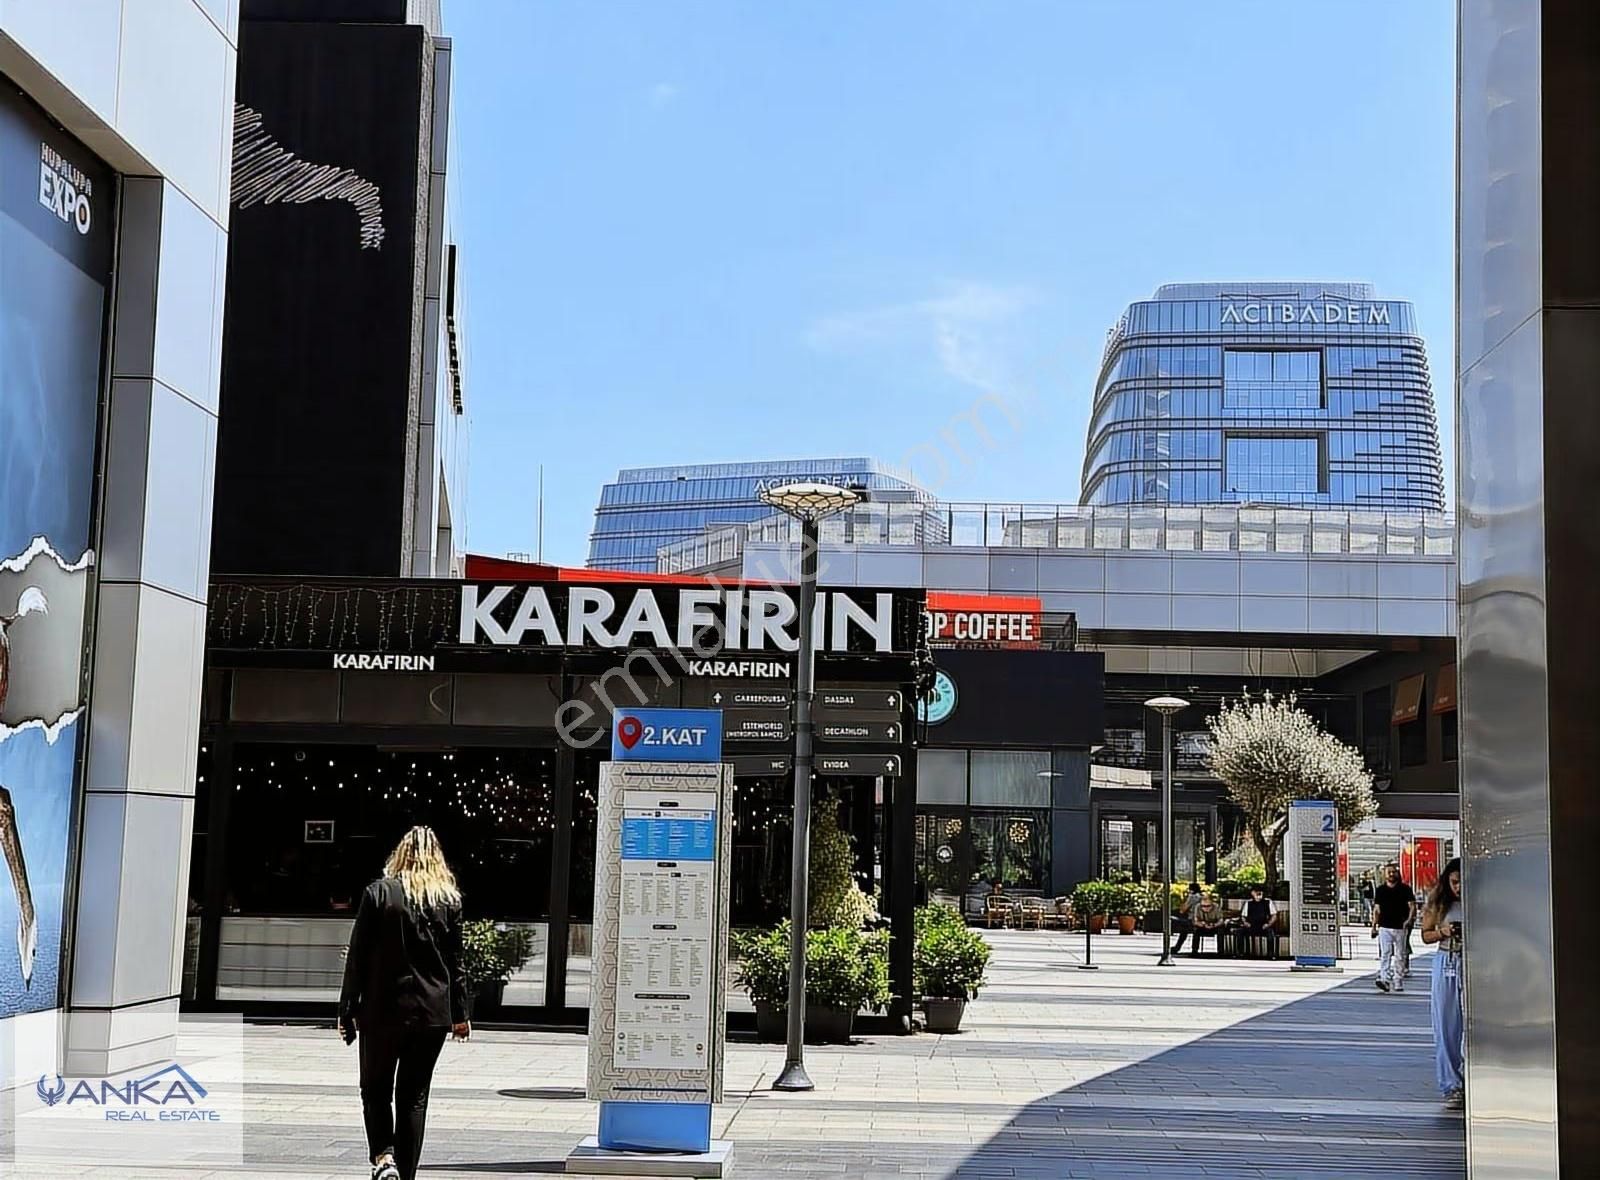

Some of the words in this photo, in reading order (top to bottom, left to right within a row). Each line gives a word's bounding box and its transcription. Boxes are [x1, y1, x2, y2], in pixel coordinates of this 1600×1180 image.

[39, 161, 91, 235] EXPO
[1220, 303, 1391, 324] ACIBADEM
[459, 584, 893, 653] KARAFIRIN
[954, 612, 1033, 641] COFFEE
[333, 653, 435, 671] KARAFIRIN
[688, 660, 790, 678] KARAFIRIN
[643, 726, 707, 746] 2.KAT
[1322, 814, 1334, 832] 2
